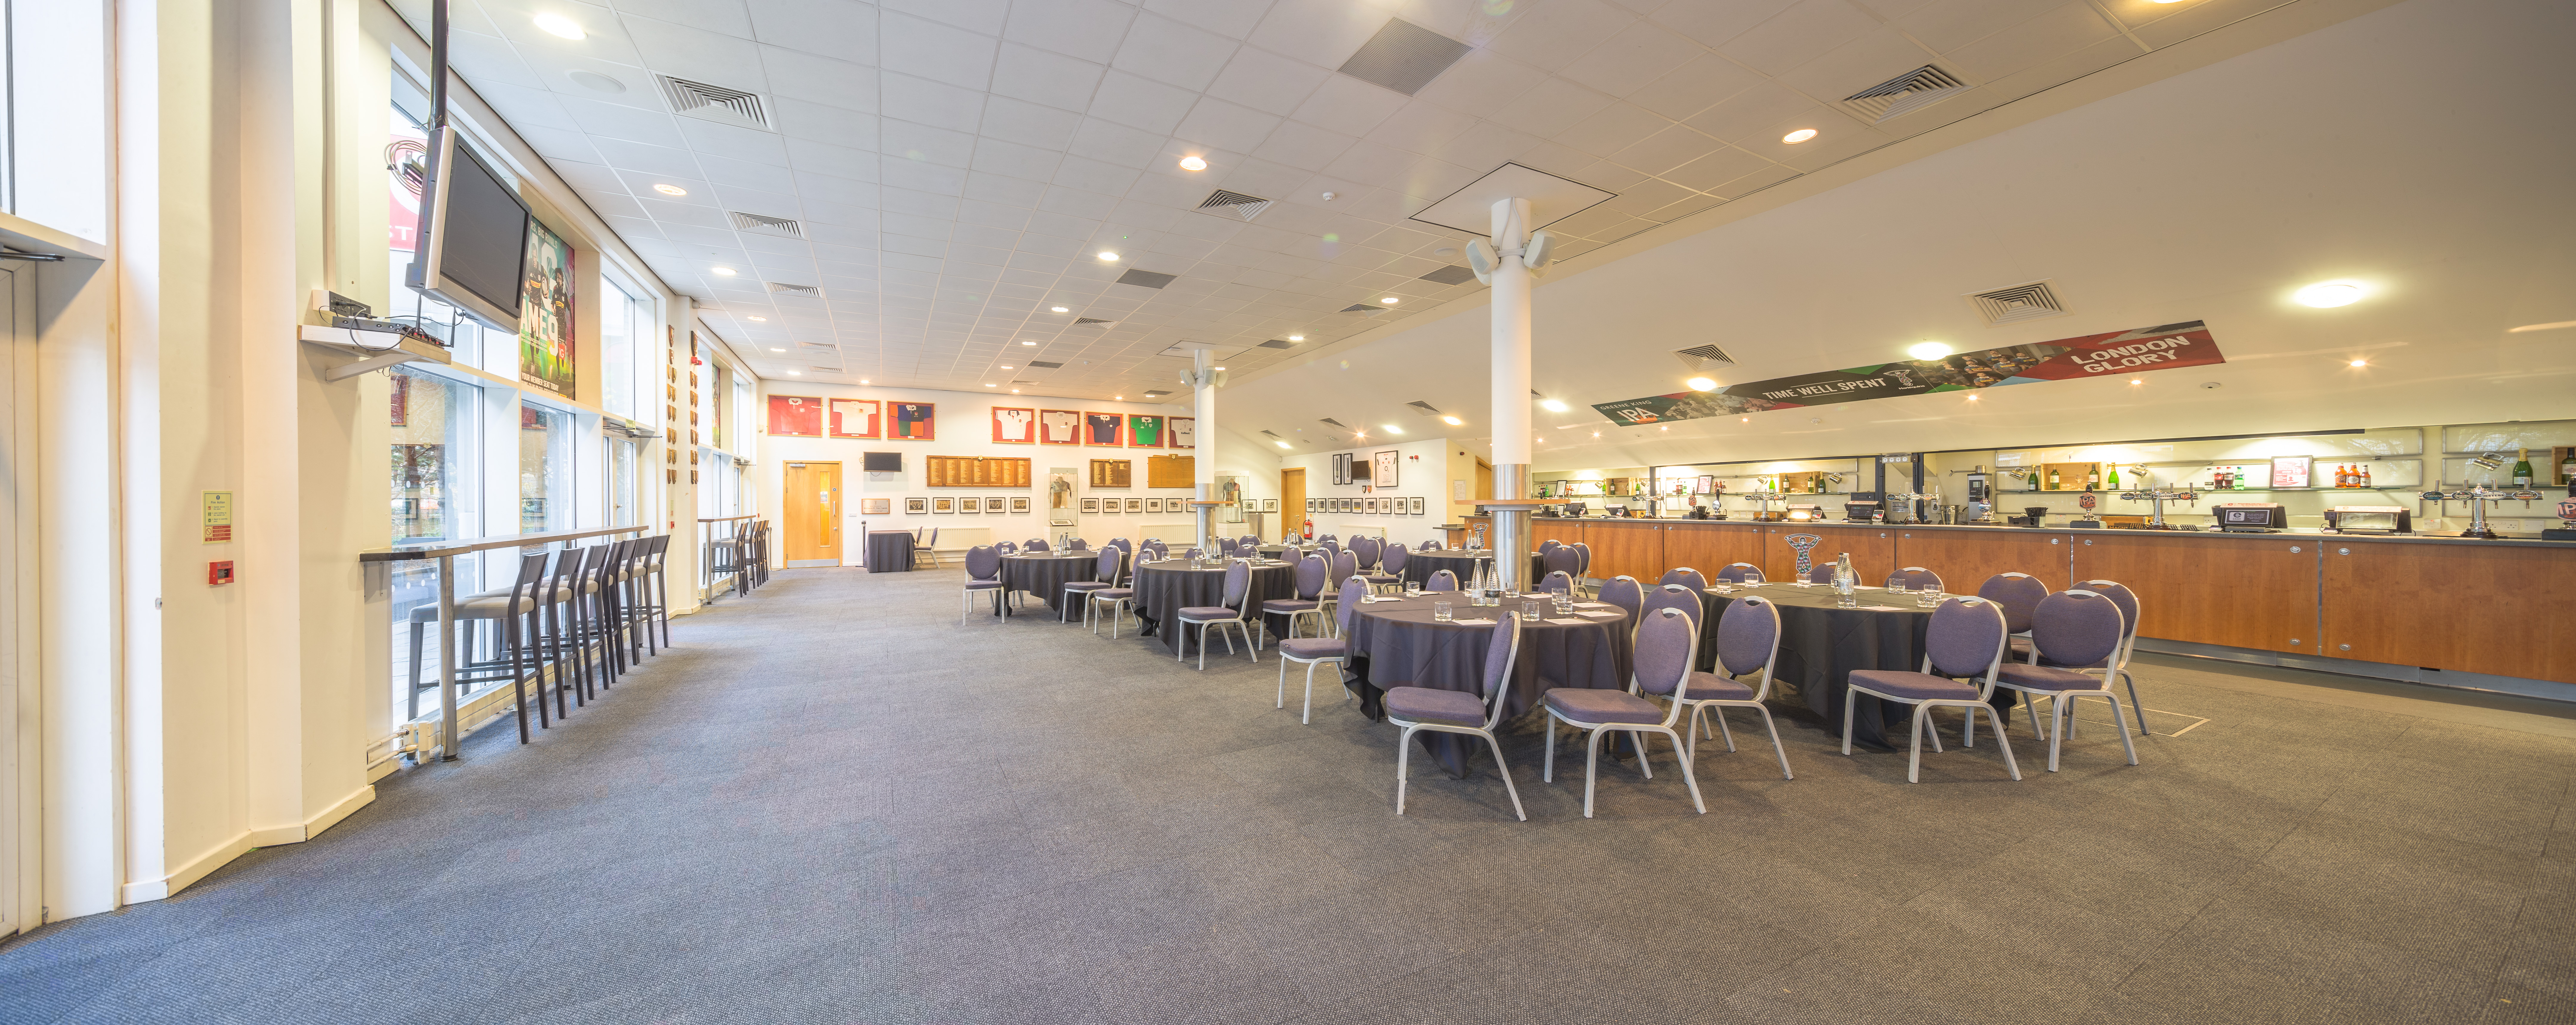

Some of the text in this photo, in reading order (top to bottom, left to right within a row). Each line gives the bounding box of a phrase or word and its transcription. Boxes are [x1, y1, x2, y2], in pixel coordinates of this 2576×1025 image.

[545, 232, 557, 249] RIVALS
[521, 298, 547, 341] AME
[527, 336, 540, 345] GLOUCESTER
[559, 348, 564, 358] IG
[2071, 336, 2191, 364] LONDON
[2083, 350, 2177, 372] GLORY
[521, 372, 530, 381] YOUR
[530, 375, 543, 386] MEMBER
[550, 383, 559, 391] TODAY
[1762, 378, 1887, 399] TIME WELL SPENT
[1616, 407, 1660, 421] IPA
[2080, 497, 2095, 505] IPA
[2558, 504, 2576, 514] IP
